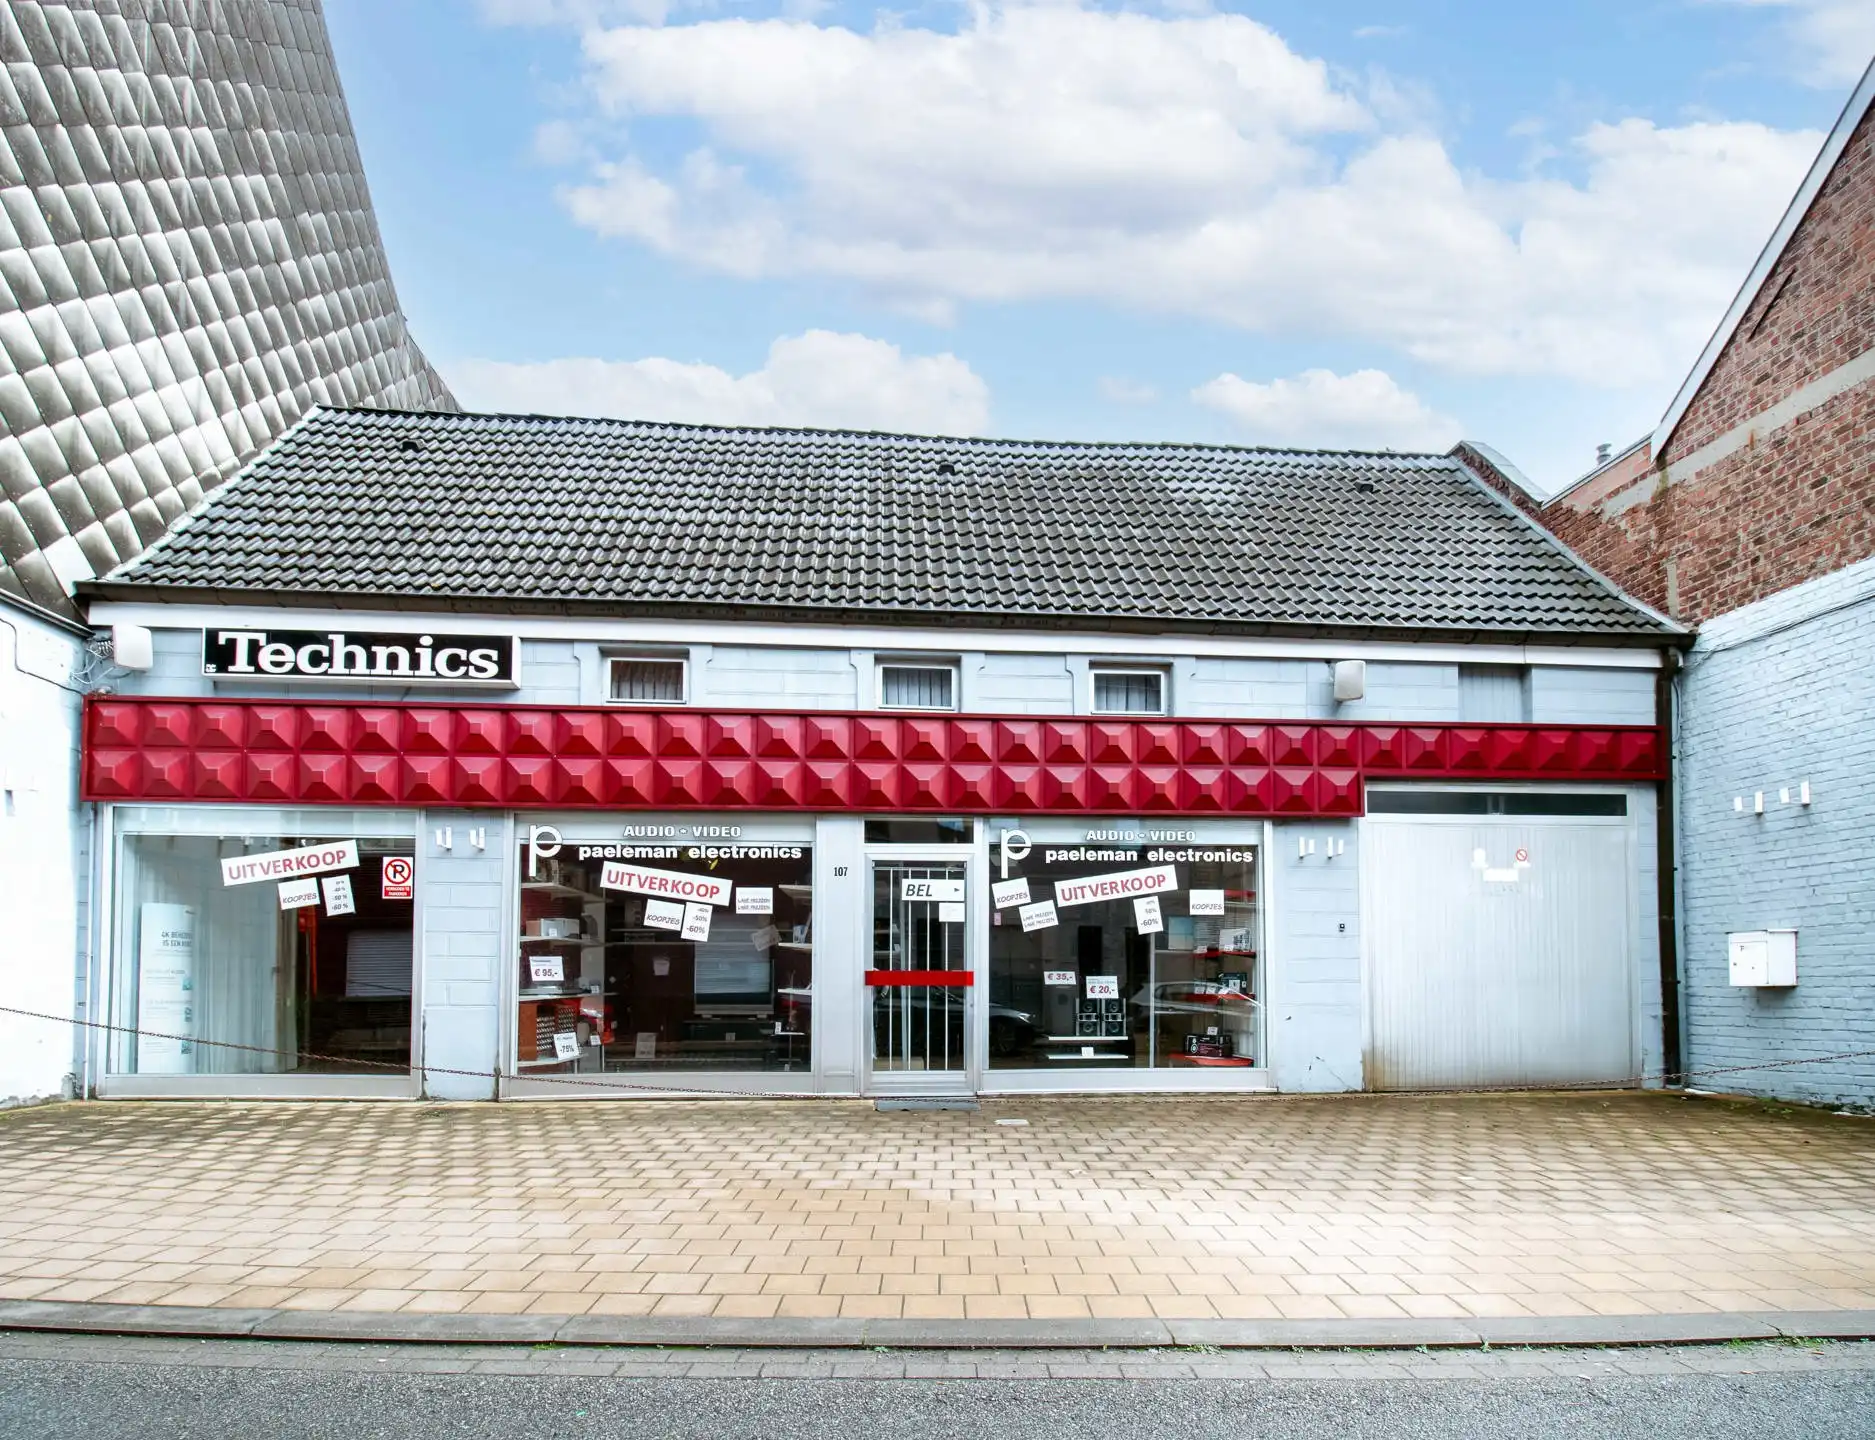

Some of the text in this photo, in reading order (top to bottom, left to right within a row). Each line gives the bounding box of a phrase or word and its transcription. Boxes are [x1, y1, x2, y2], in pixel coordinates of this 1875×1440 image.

[218, 631, 499, 678] Technics
[623, 825, 675, 837] AUDIO
[692, 826, 742, 837] VIDEO
[1086, 830, 1134, 841] AUDIO
[1149, 830, 1196, 841] VIDEO
[578, 844, 802, 861] paeleman electronics
[1045, 848, 1253, 863] paeleman electronics
[228, 850, 346, 880] UITVERKOOP
[833, 867, 848, 876] 107
[606, 869, 720, 899] UITVERKOOP
[1061, 874, 1166, 902] UITVERKOOP
[905, 884, 933, 897] BEL
[282, 893, 317, 904] KOOPJES
[996, 892, 1028, 903] KOOPJES
[646, 914, 680, 925] KOOPJES
[1140, 918, 1159, 926] -60%
[686, 925, 705, 934] -60%
